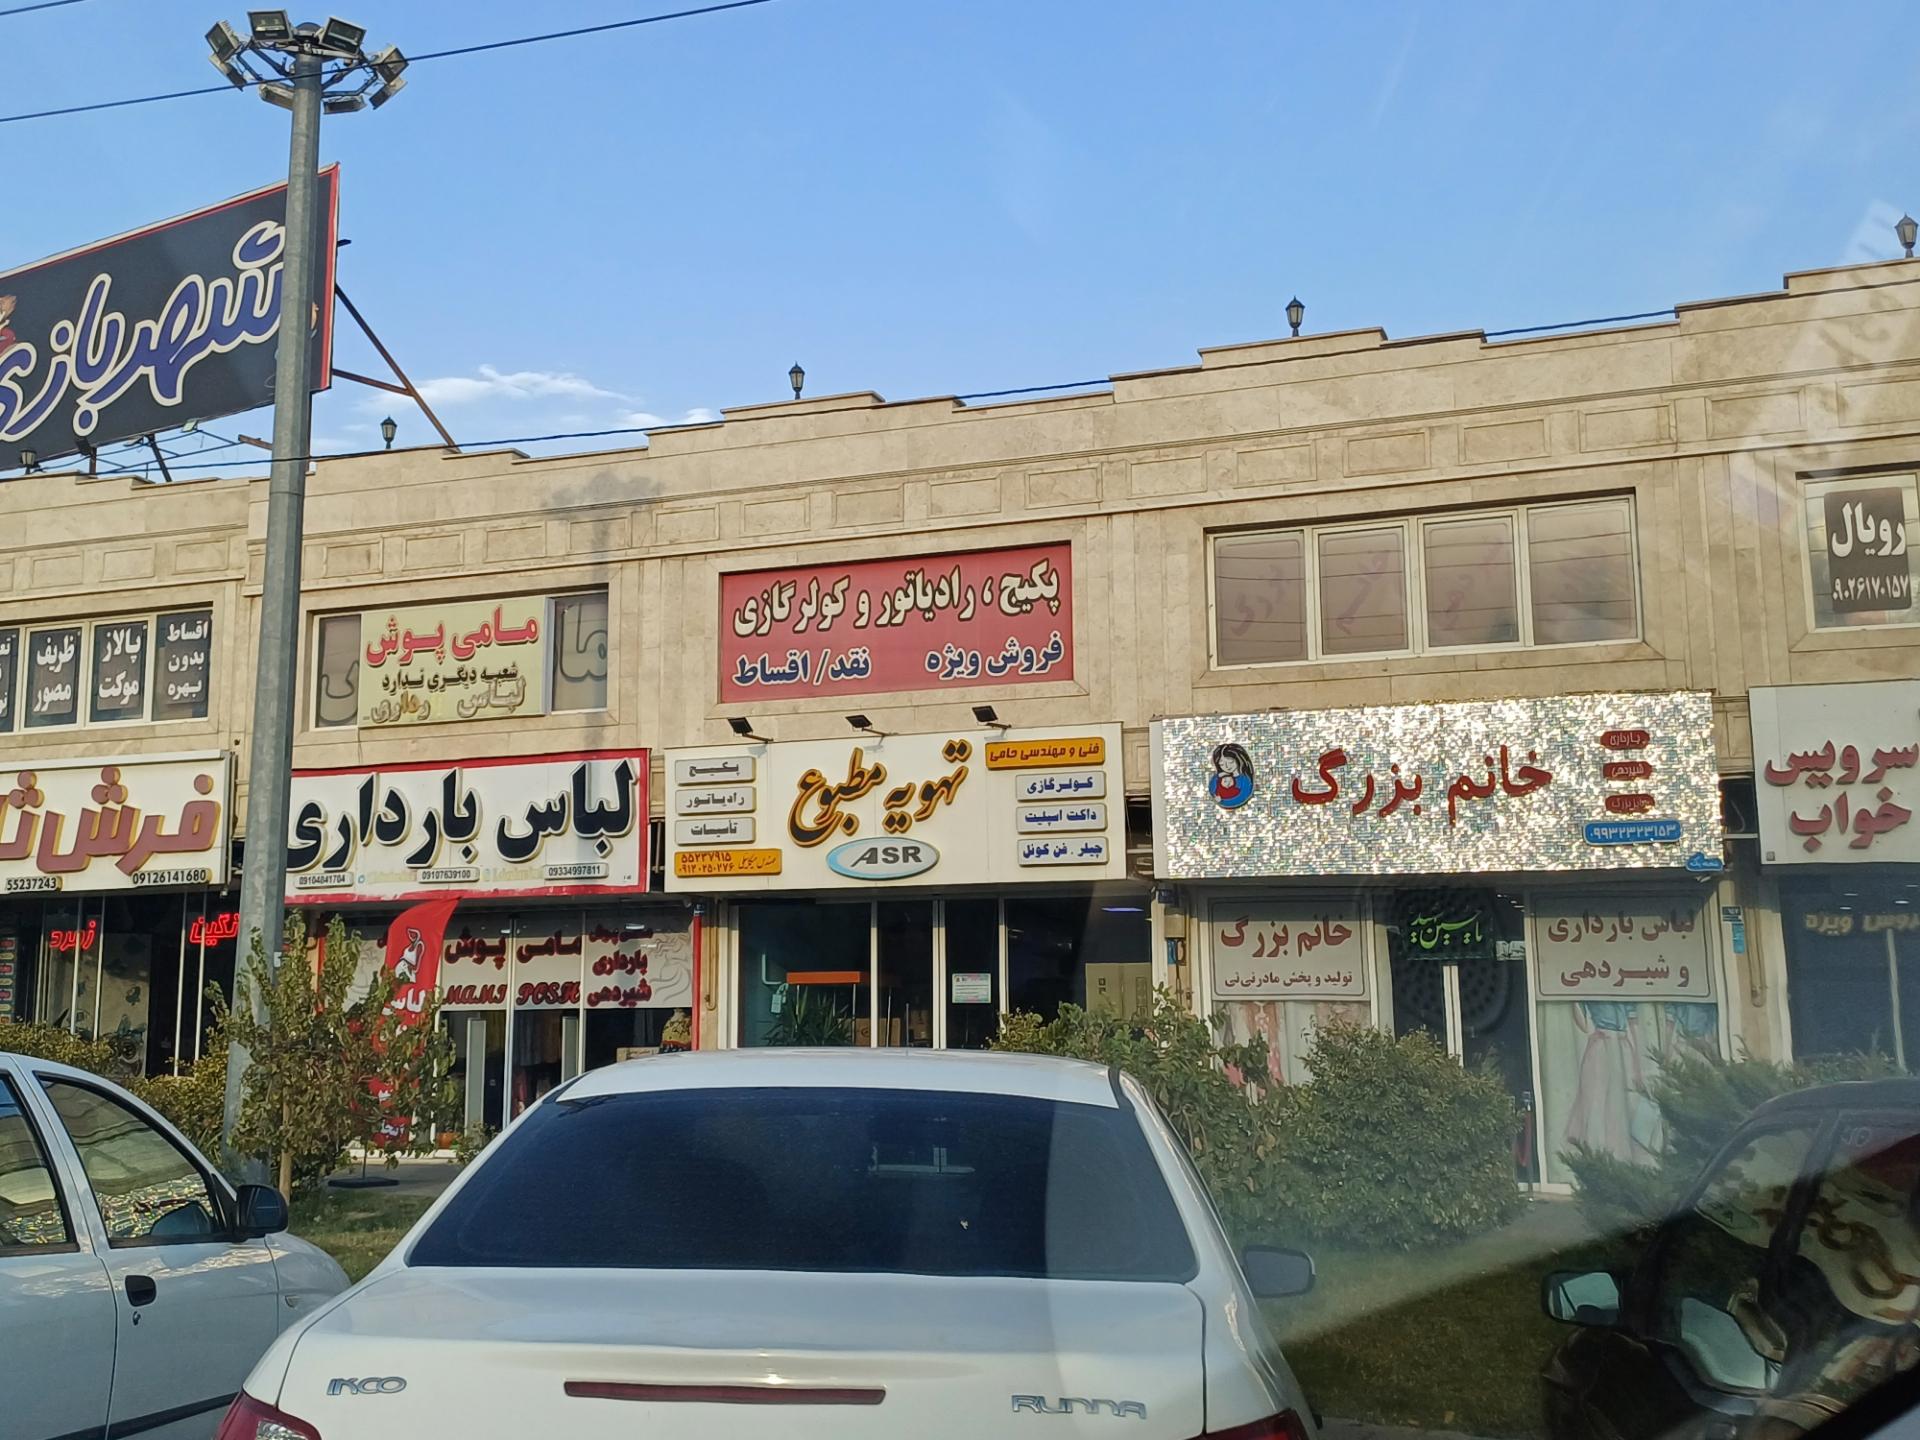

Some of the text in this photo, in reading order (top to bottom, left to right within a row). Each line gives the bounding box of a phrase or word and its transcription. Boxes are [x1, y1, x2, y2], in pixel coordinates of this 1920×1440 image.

[1832, 502, 1906, 557] رویال
[876, 566, 975, 627] رادیاتور
[1000, 558, 1059, 616] پکیج
[1833, 575, 1909, 600] ۰۹۰۲۶۱۷۰۱۵۷
[734, 580, 796, 637] گازی
[794, 575, 850, 633] کولر
[855, 591, 871, 628] و
[102, 624, 142, 664] پالاز
[166, 621, 208, 642] اقساط
[365, 603, 539, 667] مامی پوش
[36, 633, 75, 673] ظریف
[168, 651, 205, 672] بدون
[926, 644, 979, 680] ویژه
[987, 630, 1064, 675] فروش
[382, 669, 424, 695] ندارد
[427, 665, 476, 692] دیگری
[480, 663, 519, 682] شعبه
[734, 650, 809, 686] اقساط
[33, 683, 72, 712] مصور
[98, 671, 140, 707] موکت
[167, 679, 202, 701] بهره
[1020, 745, 1066, 761] مهندسی
[1069, 747, 1075, 757] و
[1078, 743, 1099, 758] فنی
[1610, 732, 1641, 746] بارداری
[689, 761, 740, 777] پکیج
[1612, 763, 1645, 777] شیردهی
[1764, 739, 1919, 789] سرویس
[788, 738, 973, 848] تهویه مطبوع
[1056, 776, 1093, 793] کولر
[1292, 744, 1553, 827] خانم بزرگ
[686, 792, 745, 808] رادیاتور
[37, 766, 221, 876] فرش
[286, 757, 639, 874] لباس بارداری
[1025, 808, 1097, 826] داکت اسپلیت
[1790, 786, 1912, 852] خواب
[851, 846, 922, 868] ASR
[1053, 842, 1068, 857] فن
[1078, 842, 1103, 859] چیلر
[6, 876, 58, 891] 55237243
[132, 868, 207, 885] 09126141680
[548, 866, 601, 877] 09334997811
[189, 912, 240, 947] نگین
[1221, 914, 1353, 958] خانم بزرگ
[1548, 910, 1633, 943] بارداری
[1641, 909, 1695, 941] لباس
[445, 926, 581, 970] مامی پوش
[592, 949, 648, 976] بارداری
[1560, 955, 1689, 987] و شیردهی
[587, 978, 652, 1007] شیردهی
[1314, 976, 1321, 987] و
[1325, 971, 1353, 988] تولید
[442, 982, 580, 1006] MAMI POSH
[327, 1376, 407, 1396] IKCO
